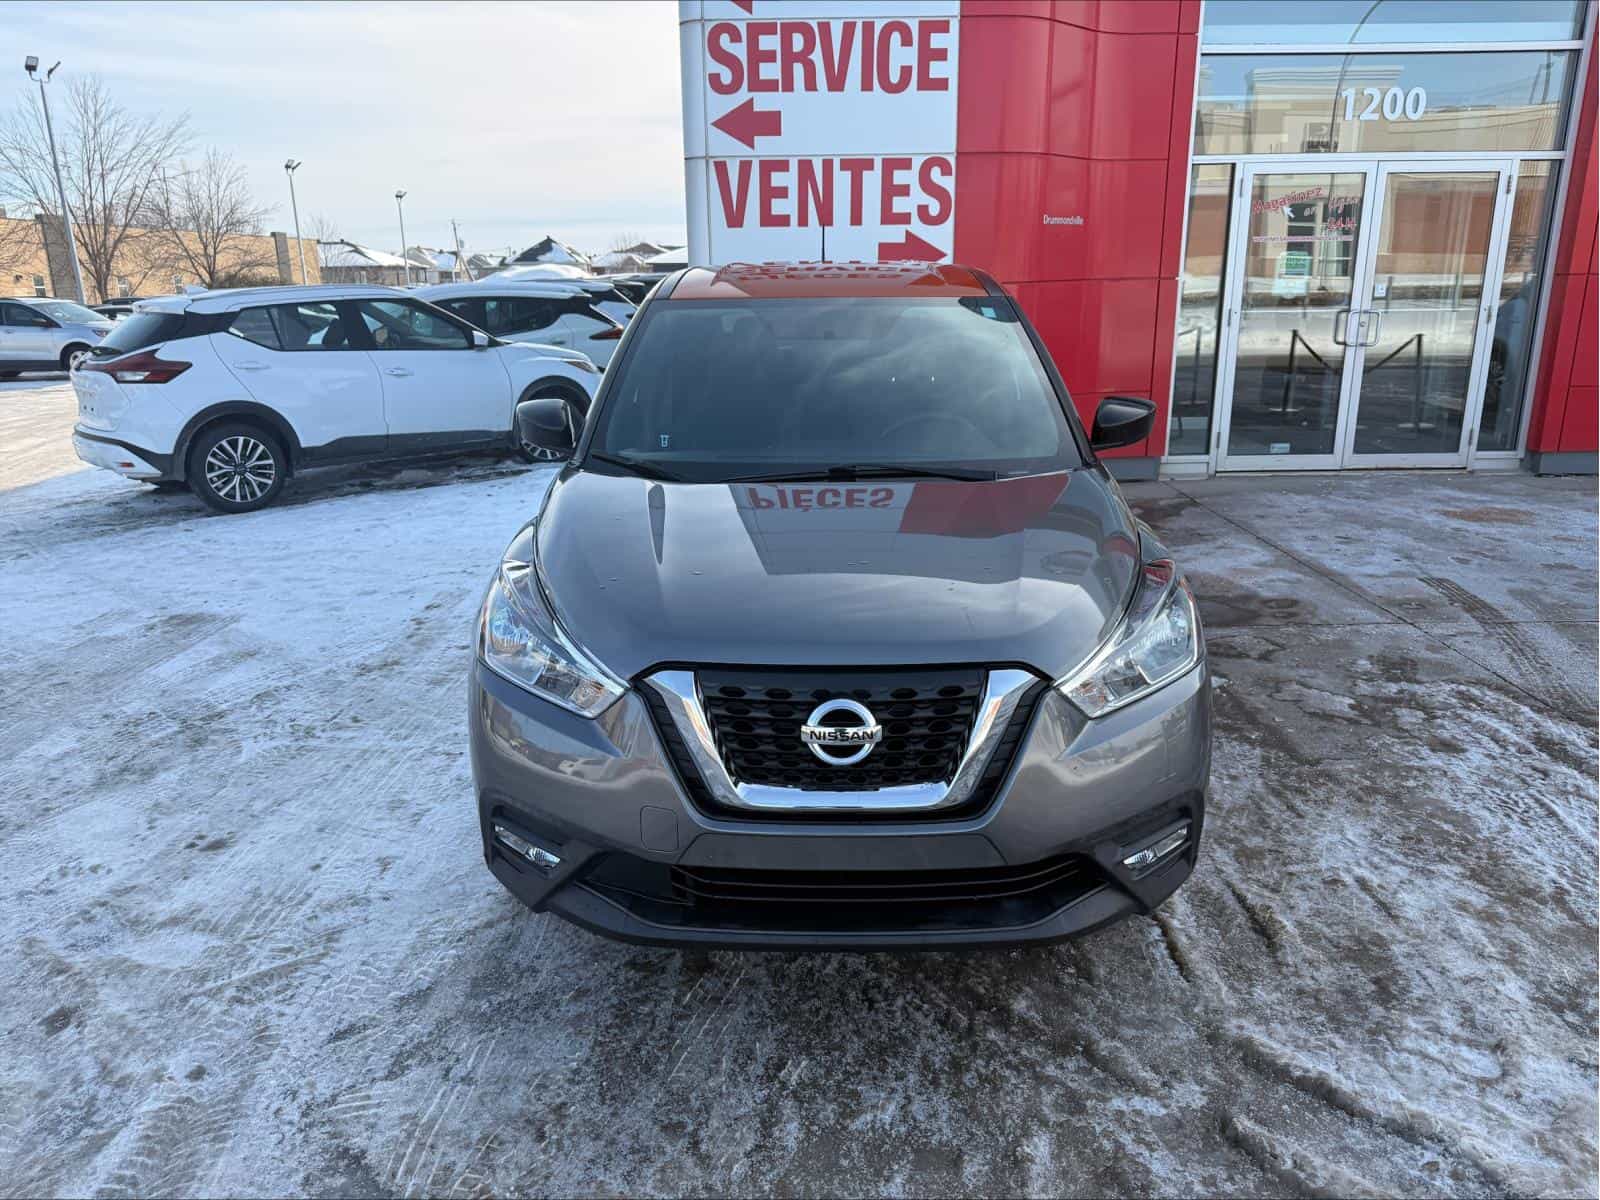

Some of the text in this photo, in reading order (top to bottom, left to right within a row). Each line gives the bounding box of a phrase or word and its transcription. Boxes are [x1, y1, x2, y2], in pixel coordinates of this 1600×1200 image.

[706, 19, 951, 95] SERVICE
[1341, 86, 1427, 121] 1200
[713, 156, 953, 229] VENTES
[809, 730, 875, 742] NISSAN
